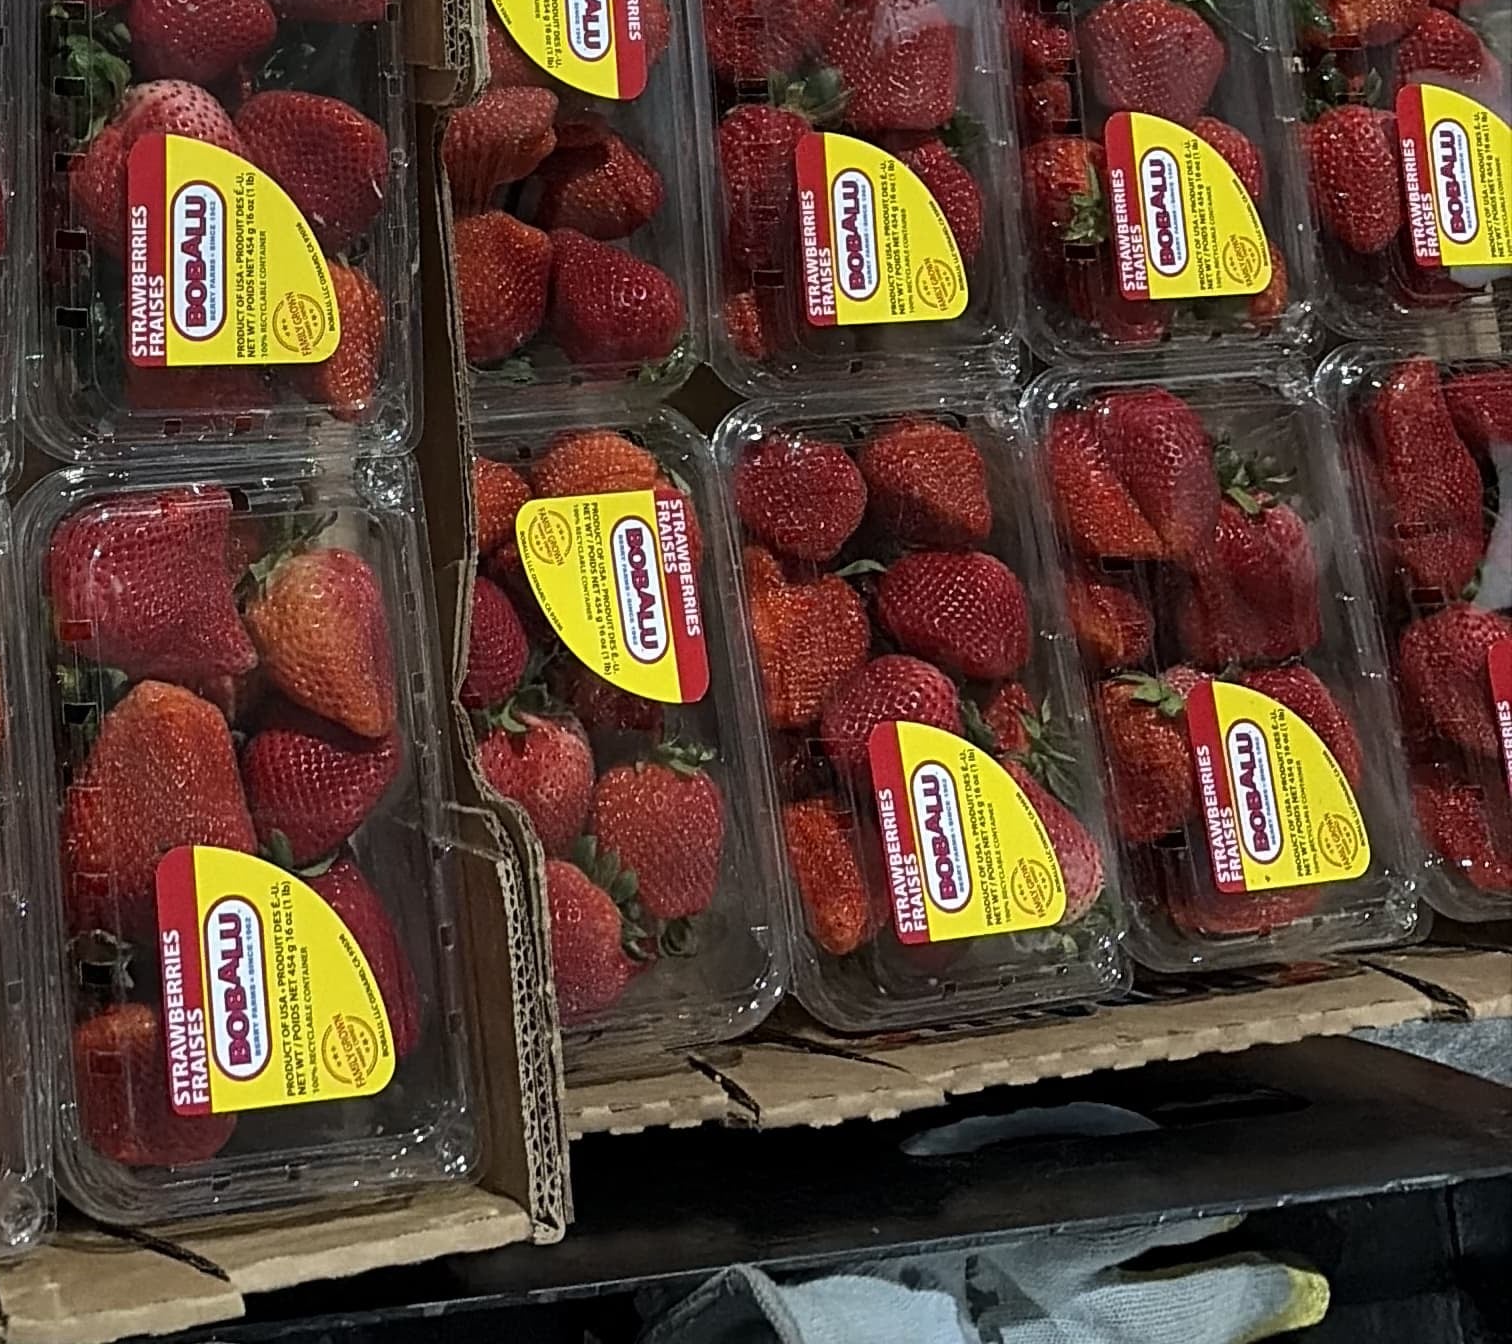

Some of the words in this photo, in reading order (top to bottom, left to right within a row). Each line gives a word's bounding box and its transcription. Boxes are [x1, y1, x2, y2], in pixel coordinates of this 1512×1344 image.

[841, 181, 865, 290] BOBALU
[1111, 168, 1135, 290] STRAWBERRIES
[1149, 159, 1175, 265] BOBALU
[1439, 130, 1466, 233] BOBALU
[131, 205, 147, 356] STRAWBERRIES
[181, 195, 206, 326] BOBALU
[802, 190, 821, 315] STRAWBERRIES
[818, 247, 834, 315] FRAISES
[1129, 224, 1147, 290] FRAISES
[149, 274, 163, 355] FRAISES
[625, 527, 658, 648] BOBALU
[655, 499, 677, 573] FRAISES
[669, 498, 700, 635] STRAWBERRIES
[921, 775, 957, 900] BOBALU
[1235, 733, 1270, 852] BOBALU
[878, 788, 913, 933] STRAWBERRIES
[903, 852, 927, 931] FRAISES
[163, 929, 190, 1105] STRAWBERRIES
[218, 912, 251, 1065] BOBALU
[186, 1008, 208, 1103] FRAISES
